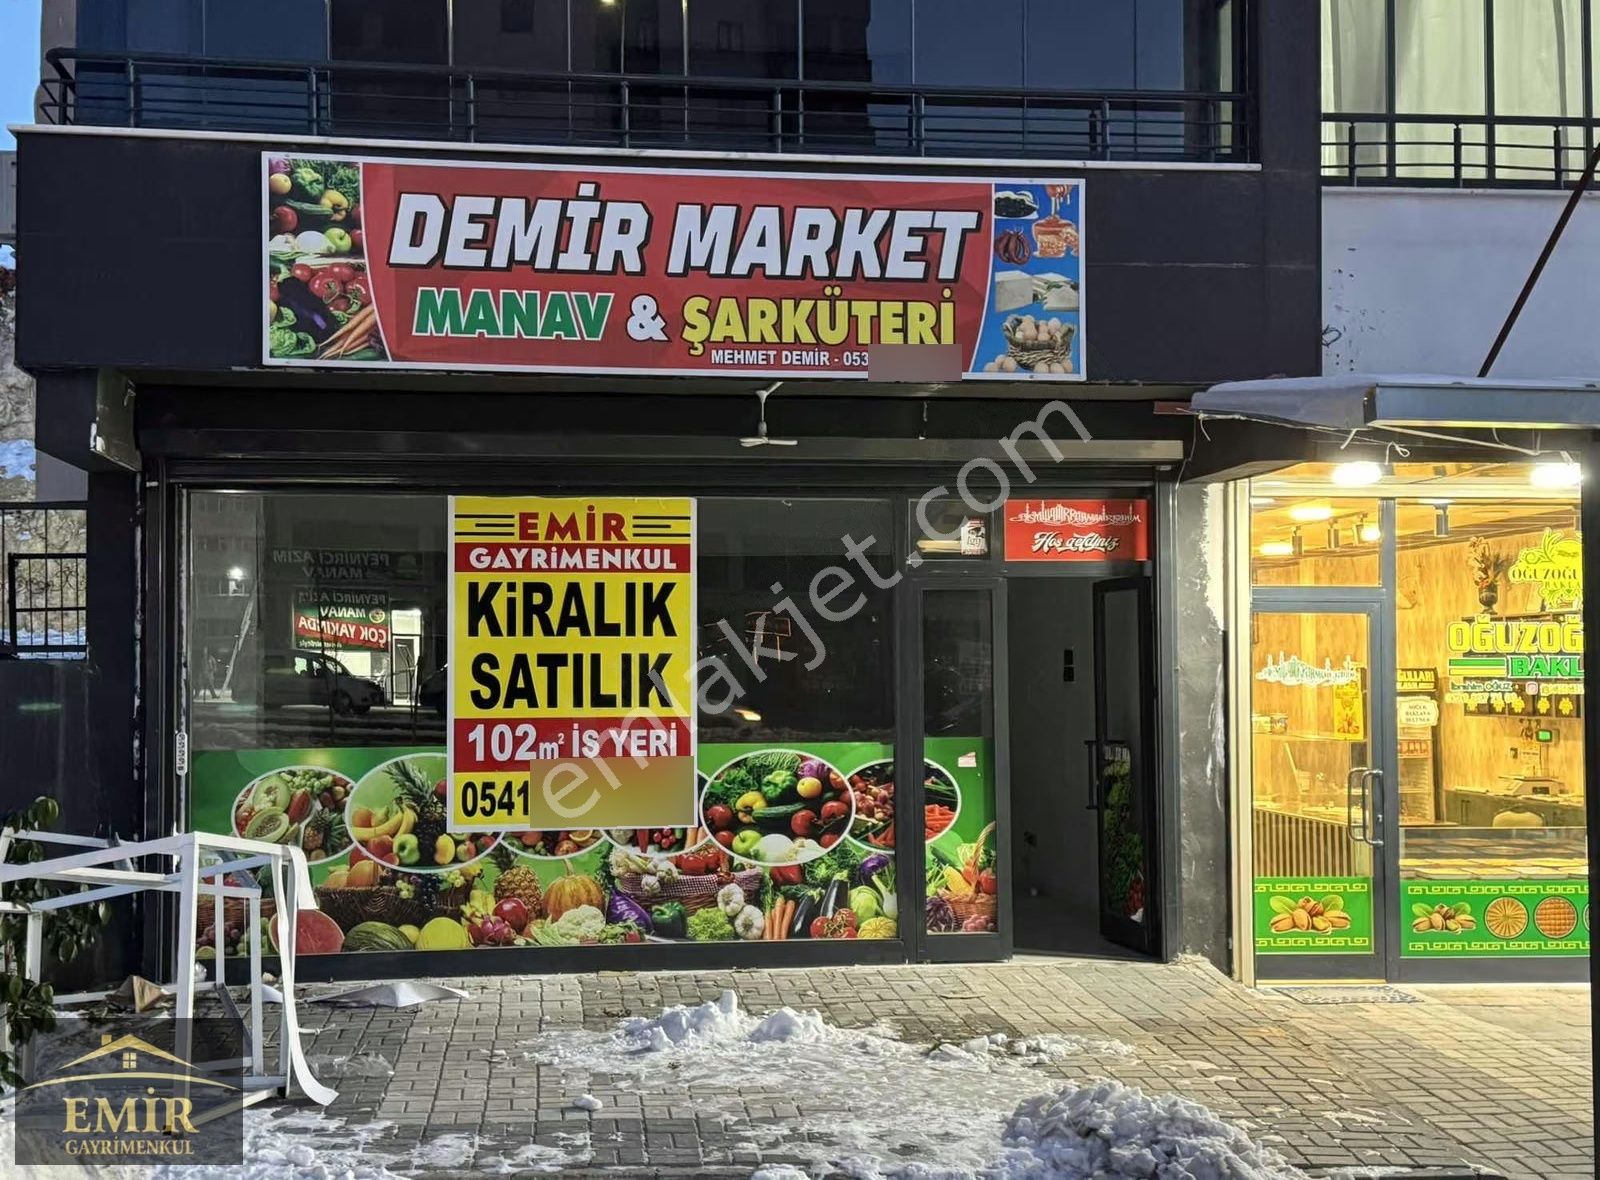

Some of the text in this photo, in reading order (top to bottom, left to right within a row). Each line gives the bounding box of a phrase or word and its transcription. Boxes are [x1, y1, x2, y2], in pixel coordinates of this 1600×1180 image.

[388, 181, 982, 283] DEMİR MARKET
[412, 285, 955, 357] MANAV & ŞARKÜTERİ
[711, 349, 777, 366] MEHMET
[781, 348, 830, 367] DEMİR
[518, 505, 629, 541] EMİR
[469, 546, 677, 570] GAYRİMENKUL
[467, 581, 678, 638] KİRALIK
[471, 651, 674, 709] SATILIK
[1510, 656, 1584, 677] BAKL
[610, 722, 678, 758] YERİ
[461, 780, 530, 817] 0541
